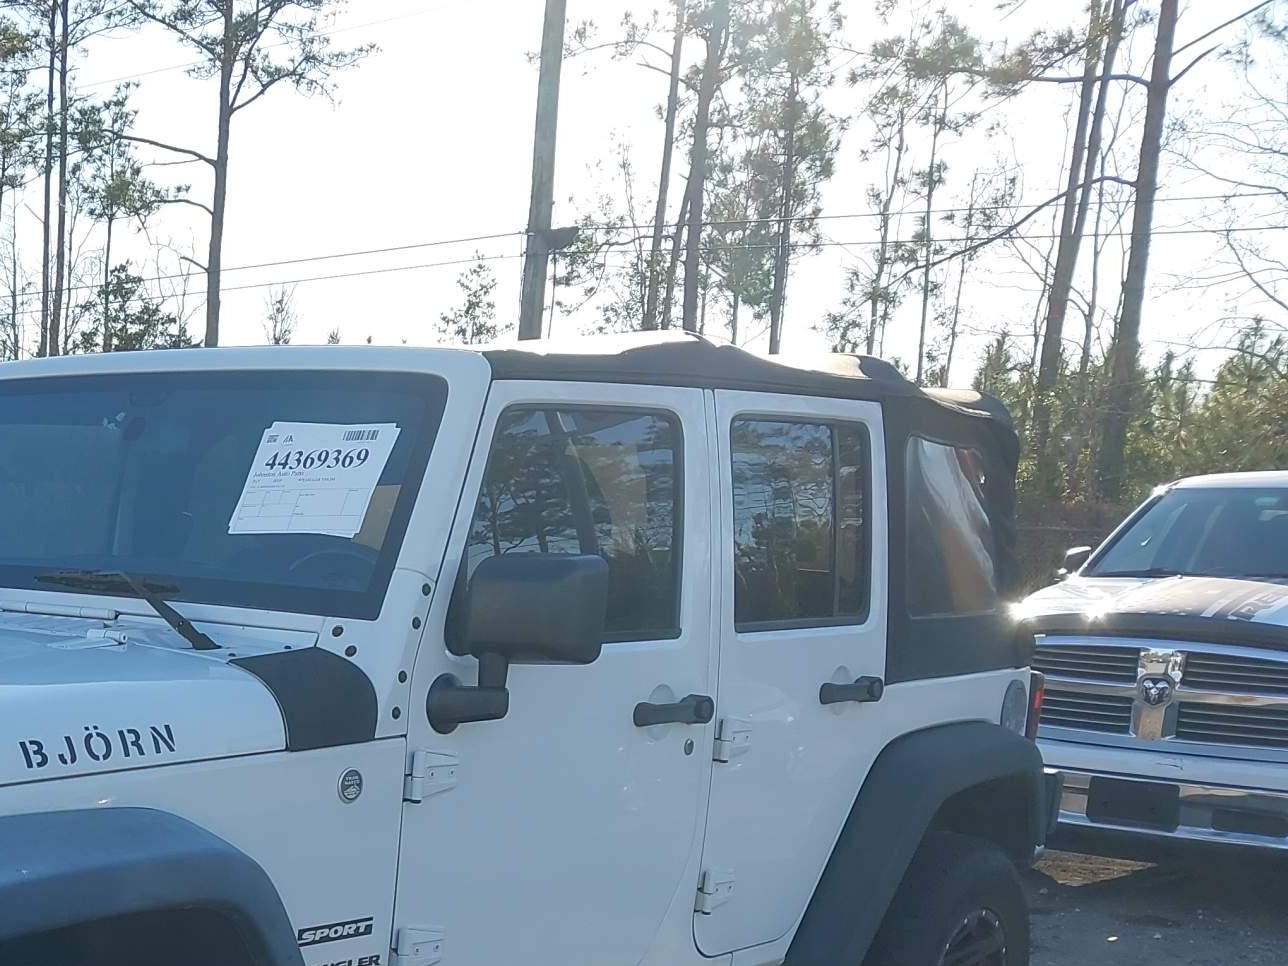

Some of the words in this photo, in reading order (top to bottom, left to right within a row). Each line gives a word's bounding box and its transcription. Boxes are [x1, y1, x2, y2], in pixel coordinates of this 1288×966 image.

[265, 448, 370, 470] 44369369
[19, 724, 176, 769] BJÖRN
[300, 920, 369, 943] SPORT
